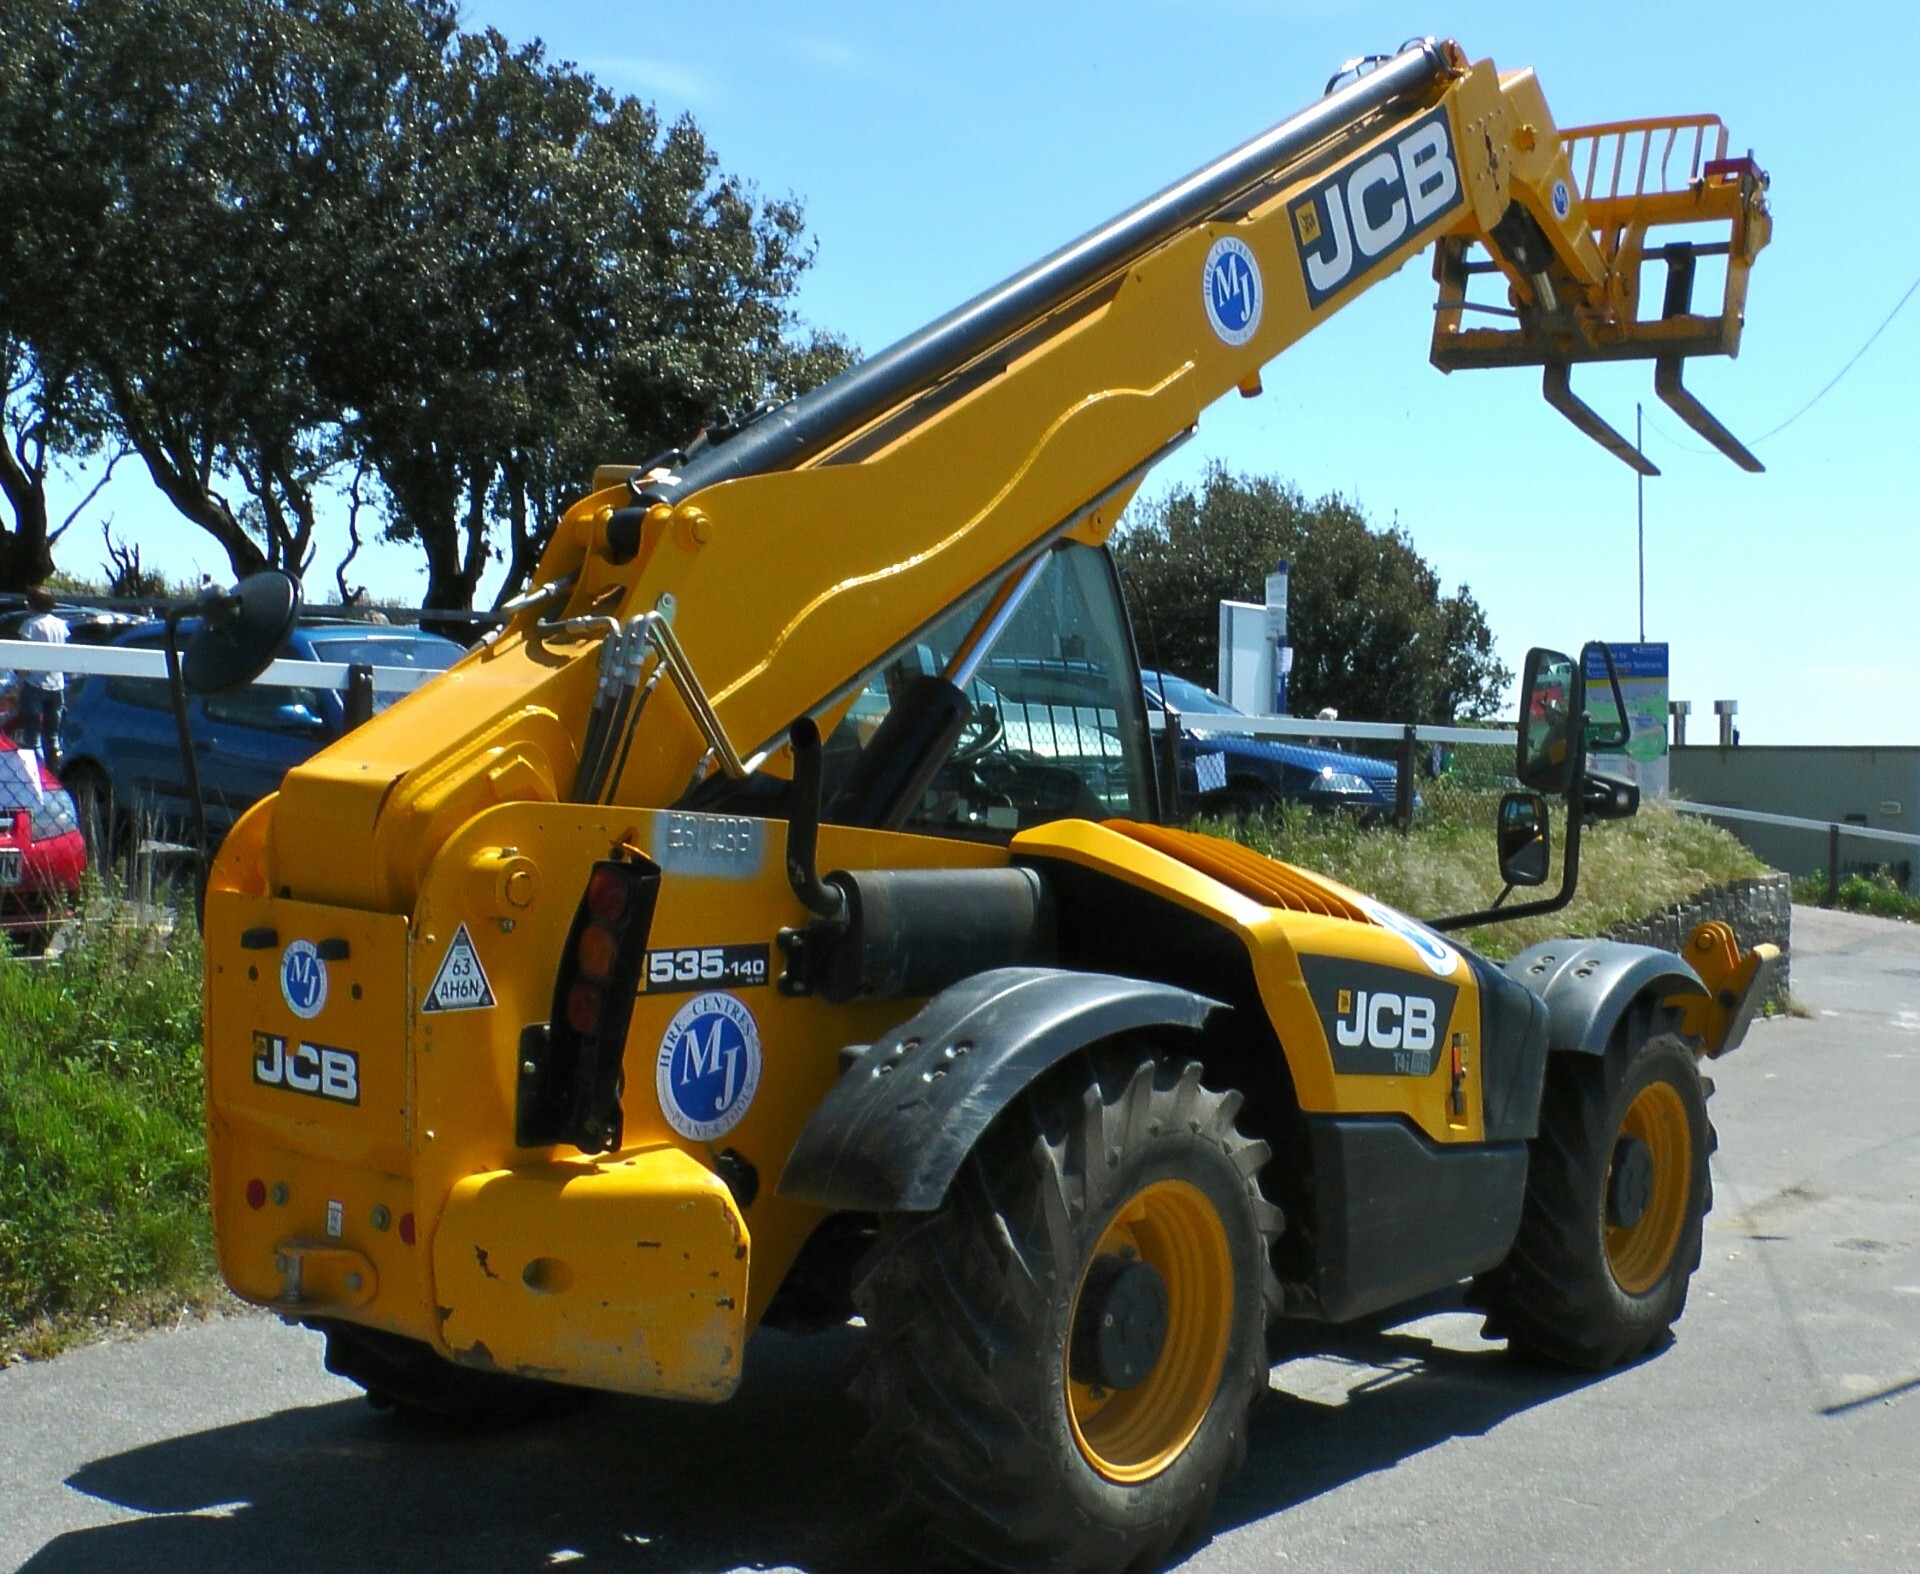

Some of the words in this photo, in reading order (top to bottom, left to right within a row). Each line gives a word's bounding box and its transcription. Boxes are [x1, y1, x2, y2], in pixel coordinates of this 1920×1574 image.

[1306, 121, 1457, 290] JCB
[1215, 254, 1250, 321] MJ
[290, 955, 318, 1006] MJ
[441, 979, 479, 1000] AH6N
[452, 958, 470, 976] 63
[659, 1020, 685, 1068] HIRE
[692, 995, 752, 1036] CENTRES
[1336, 991, 1436, 1050] JCB
[257, 1039, 357, 1099] JCB
[679, 1017, 742, 1111] MJ
